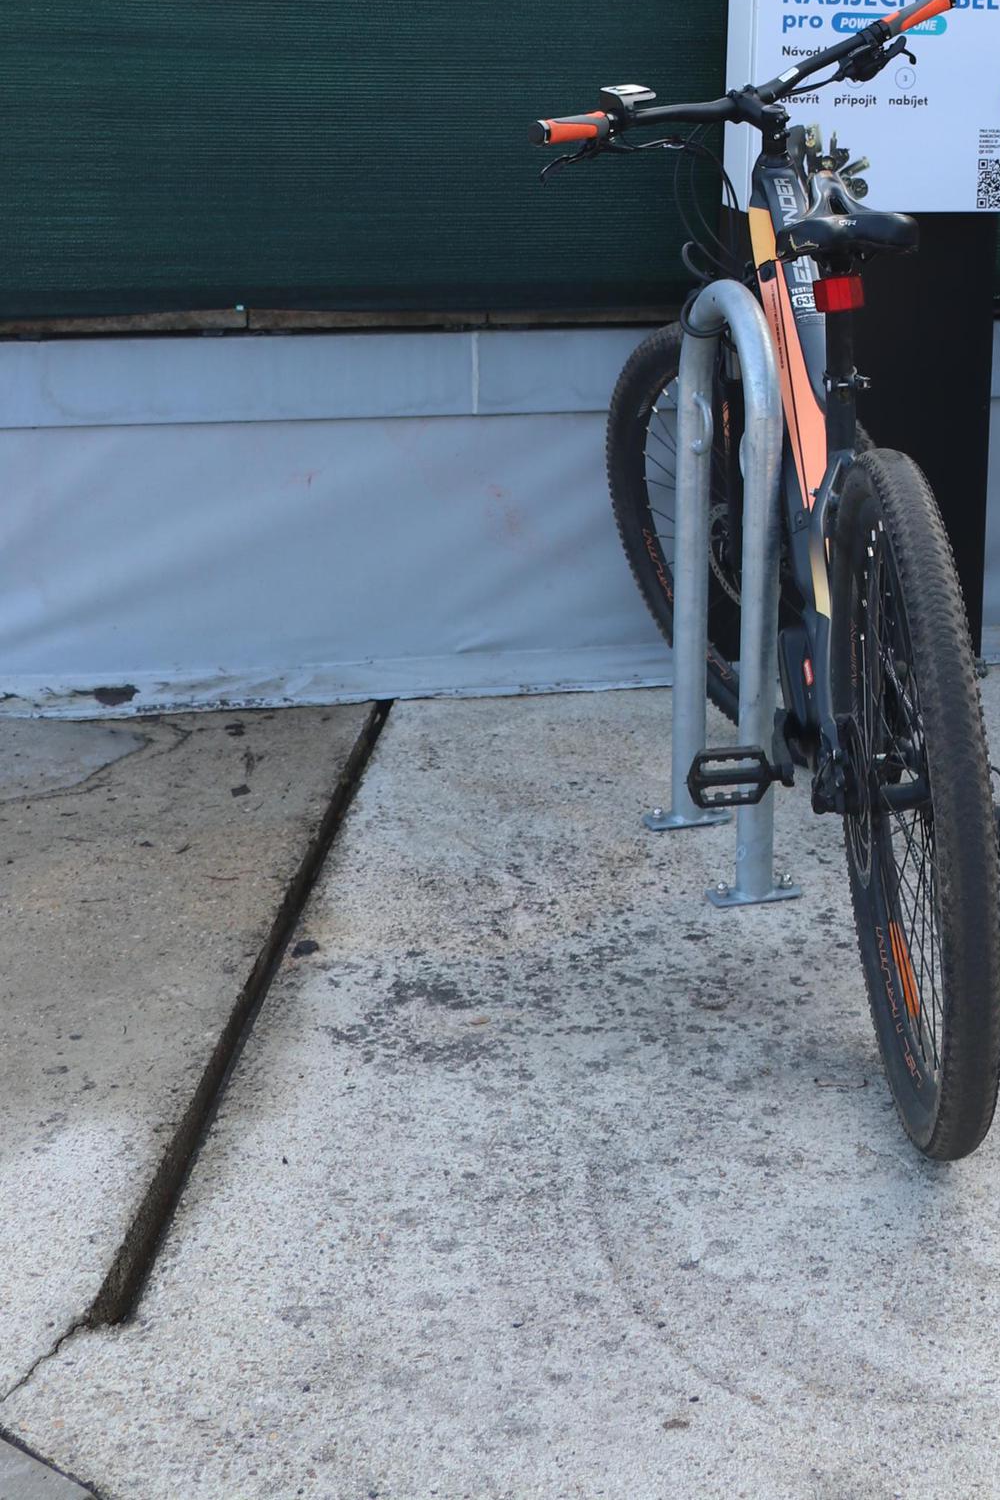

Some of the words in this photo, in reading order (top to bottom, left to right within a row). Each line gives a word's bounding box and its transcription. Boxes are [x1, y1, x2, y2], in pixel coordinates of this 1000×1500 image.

[782, 14, 823, 33] pro
[781, 45, 821, 58] Návod
[834, 94, 877, 108] připojit
[888, 94, 929, 108] nabíjet
